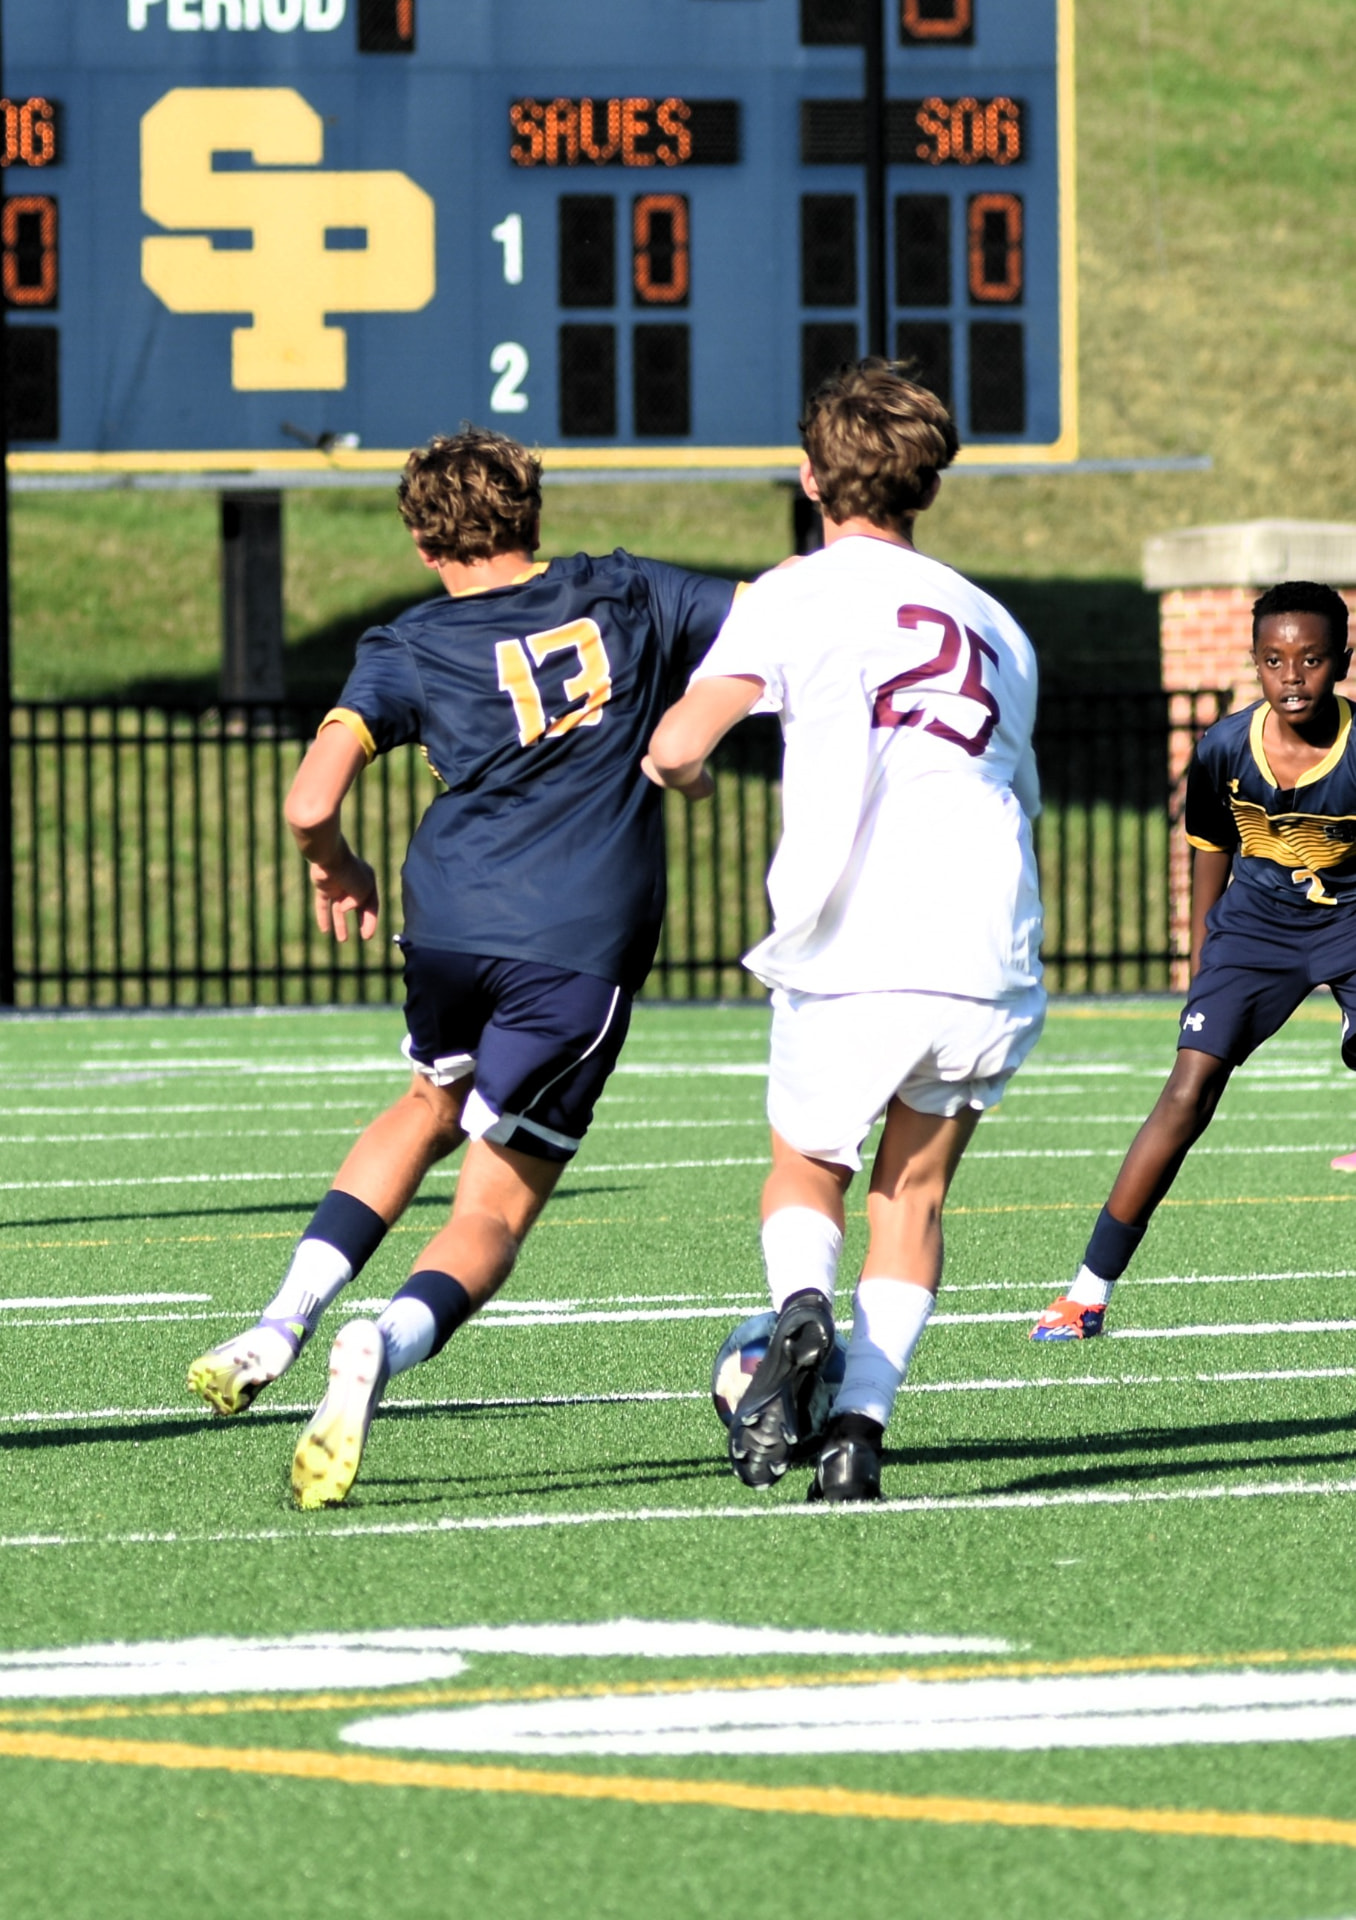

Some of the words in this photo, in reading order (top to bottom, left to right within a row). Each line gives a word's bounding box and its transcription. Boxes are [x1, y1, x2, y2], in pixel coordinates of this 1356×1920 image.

[510, 98, 692, 166] SAVES
[916, 97, 1020, 166] SOG
[3, 196, 56, 304] 0
[492, 213, 523, 284] 1
[633, 194, 690, 302] 0
[967, 194, 1022, 301] 0
[490, 342, 529, 413] 2
[495, 617, 612, 748] 13
[872, 603, 1000, 757] 25
